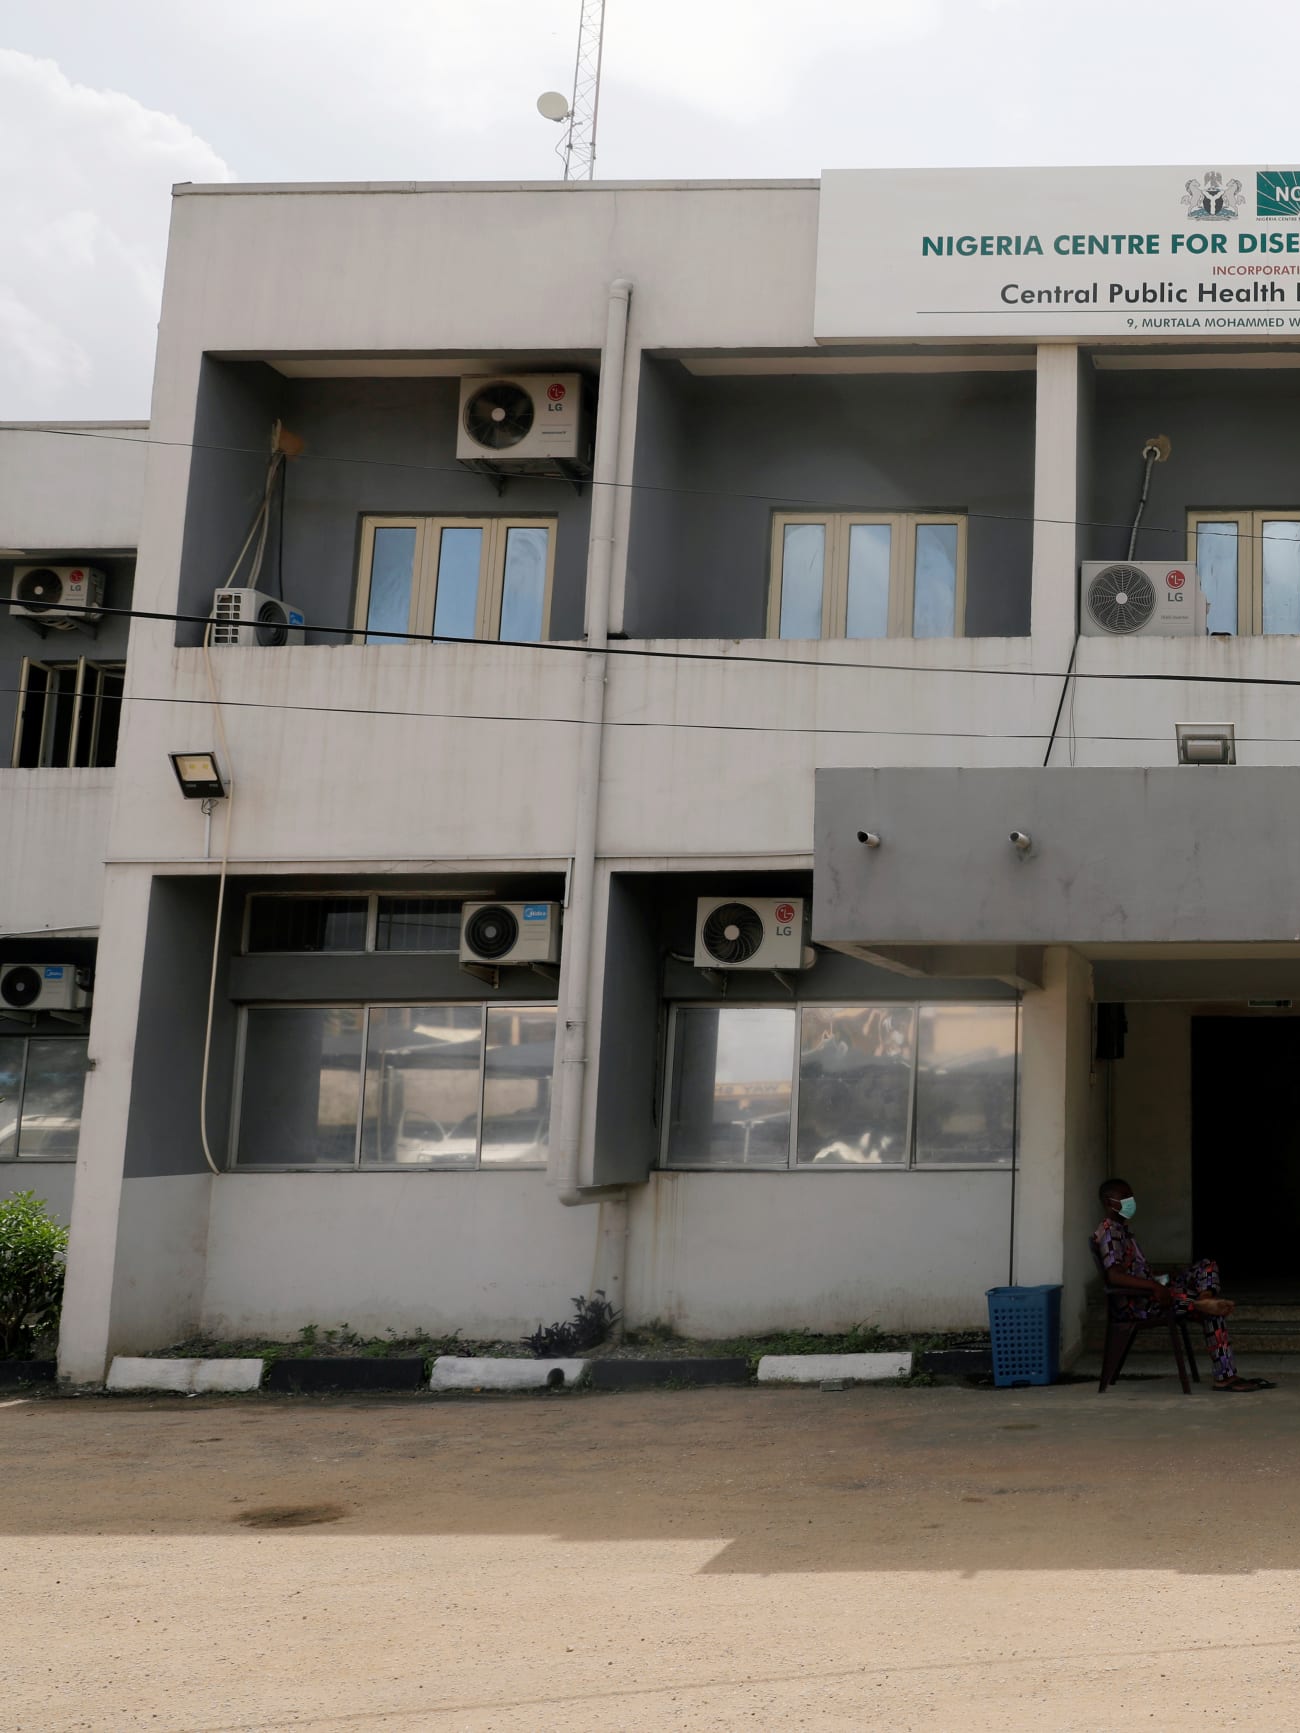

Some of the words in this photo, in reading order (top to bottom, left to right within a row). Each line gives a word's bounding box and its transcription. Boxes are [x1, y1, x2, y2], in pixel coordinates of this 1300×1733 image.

[923, 236, 1043, 256] NIGERIA
[1054, 235, 1159, 255] CENTRE
[1172, 234, 1227, 254] FOR
[1001, 283, 1097, 304] Central
[1110, 282, 1187, 303] Public
[1199, 282, 1284, 302] Health
[1127, 318, 1137, 329] 9,
[1142, 318, 1200, 328] MURTALA
[1205, 318, 1284, 327] MOHAMMED
[548, 403, 562, 412] LG
[1167, 592, 1184, 602] LG
[776, 926, 792, 937] LG
